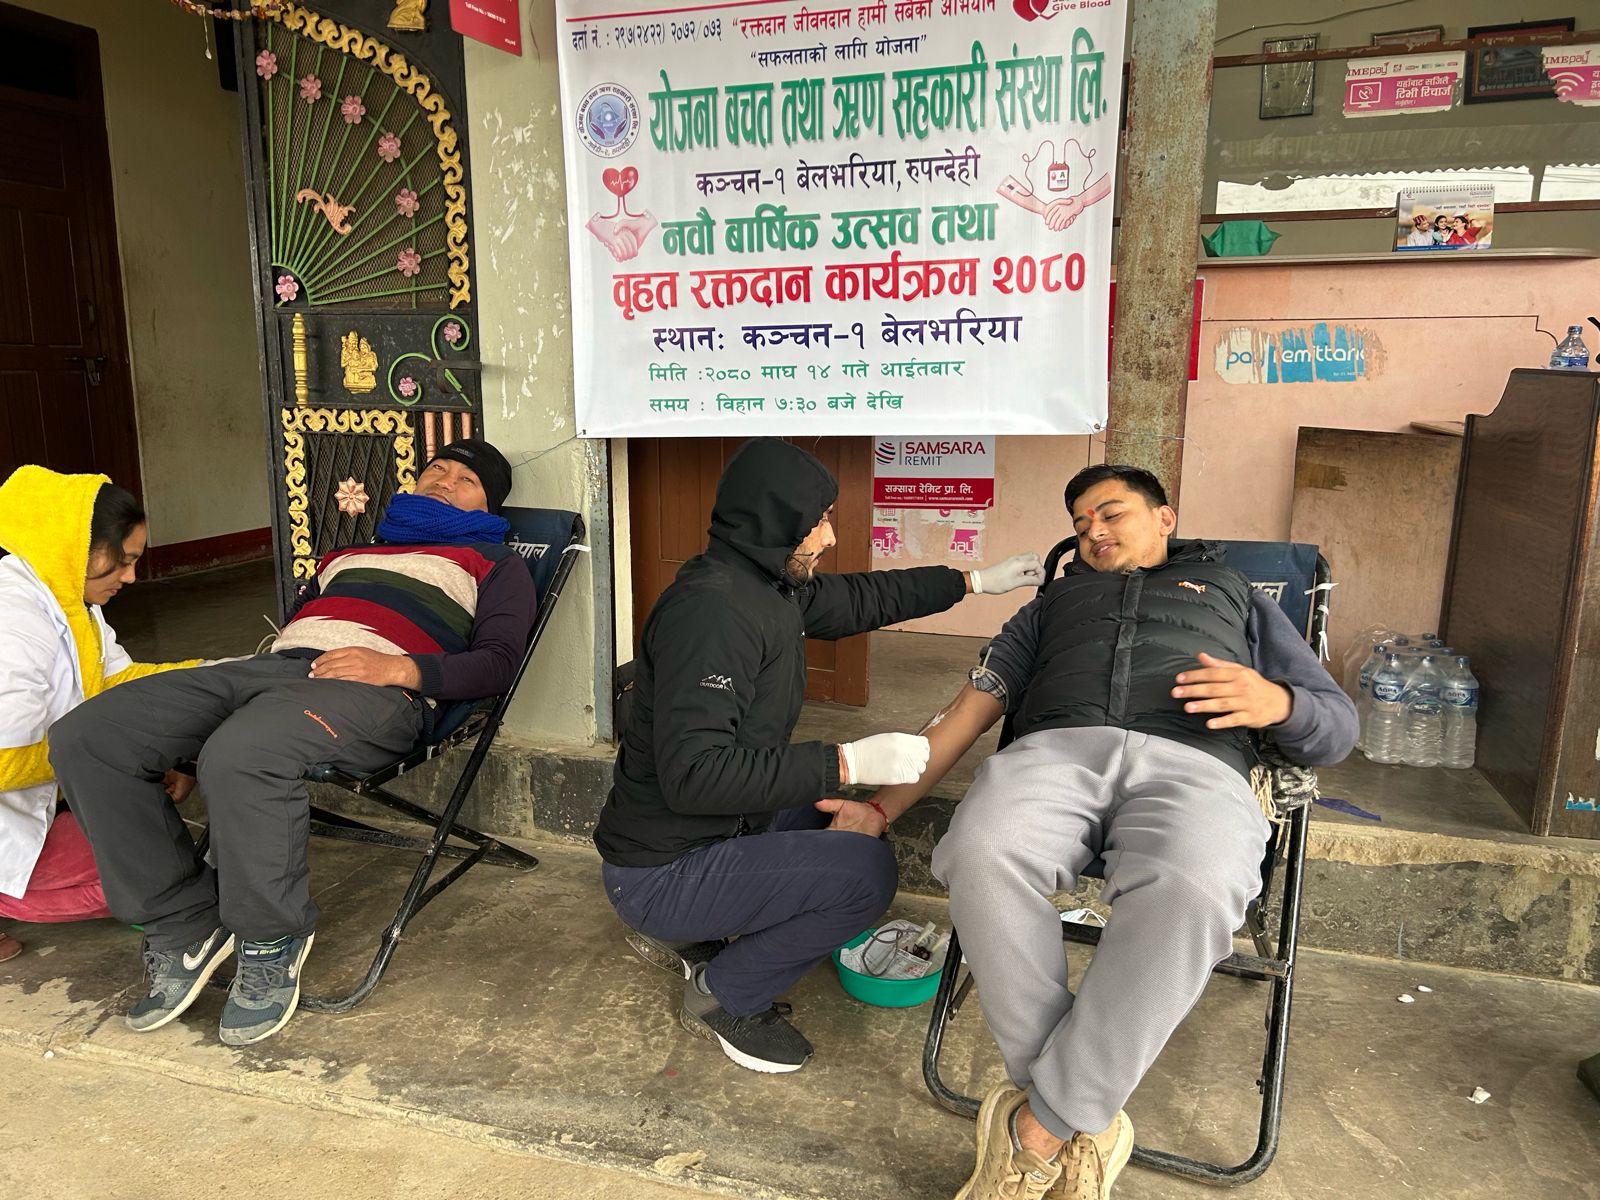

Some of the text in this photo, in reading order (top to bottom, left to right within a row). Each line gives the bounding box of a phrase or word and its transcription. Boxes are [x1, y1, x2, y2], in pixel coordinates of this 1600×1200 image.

[793, 6, 852, 33] जीवनदान
[857, 0, 888, 32] हामी
[1052, 0, 1111, 11] Give Blood
[834, 36, 868, 61] लागि
[648, 26, 1108, 153] योजना बचत तथा ऋण सहकारी संस्था लि.
[1395, 87, 1420, 100] टिभी
[695, 145, 981, 197] कञ्चन-१ बेलभरिया, रुपन्देही
[724, 203, 821, 254] बार्षिक
[831, 207, 922, 249] उत्सव
[931, 202, 999, 245] तथा
[612, 250, 1086, 320] वृहत रक्तदान कार्यक्रम २०८०
[741, 322, 865, 350] कञ्चन-१
[881, 307, 1024, 347] बेलभरिया
[648, 362, 688, 382] मिति
[760, 364, 798, 381] माघ
[806, 363, 831, 381] १४
[842, 359, 870, 378] गते
[649, 397, 690, 413] समय
[715, 392, 766, 415] विहान
[774, 396, 817, 414] ७:३०
[827, 391, 857, 411] बजे
[866, 389, 904, 410] देखि
[904, 441, 986, 455] SAMSARA
[904, 455, 943, 466] REMIT
[884, 482, 974, 495] सम्सारा रेमिट प्रा. लि.
